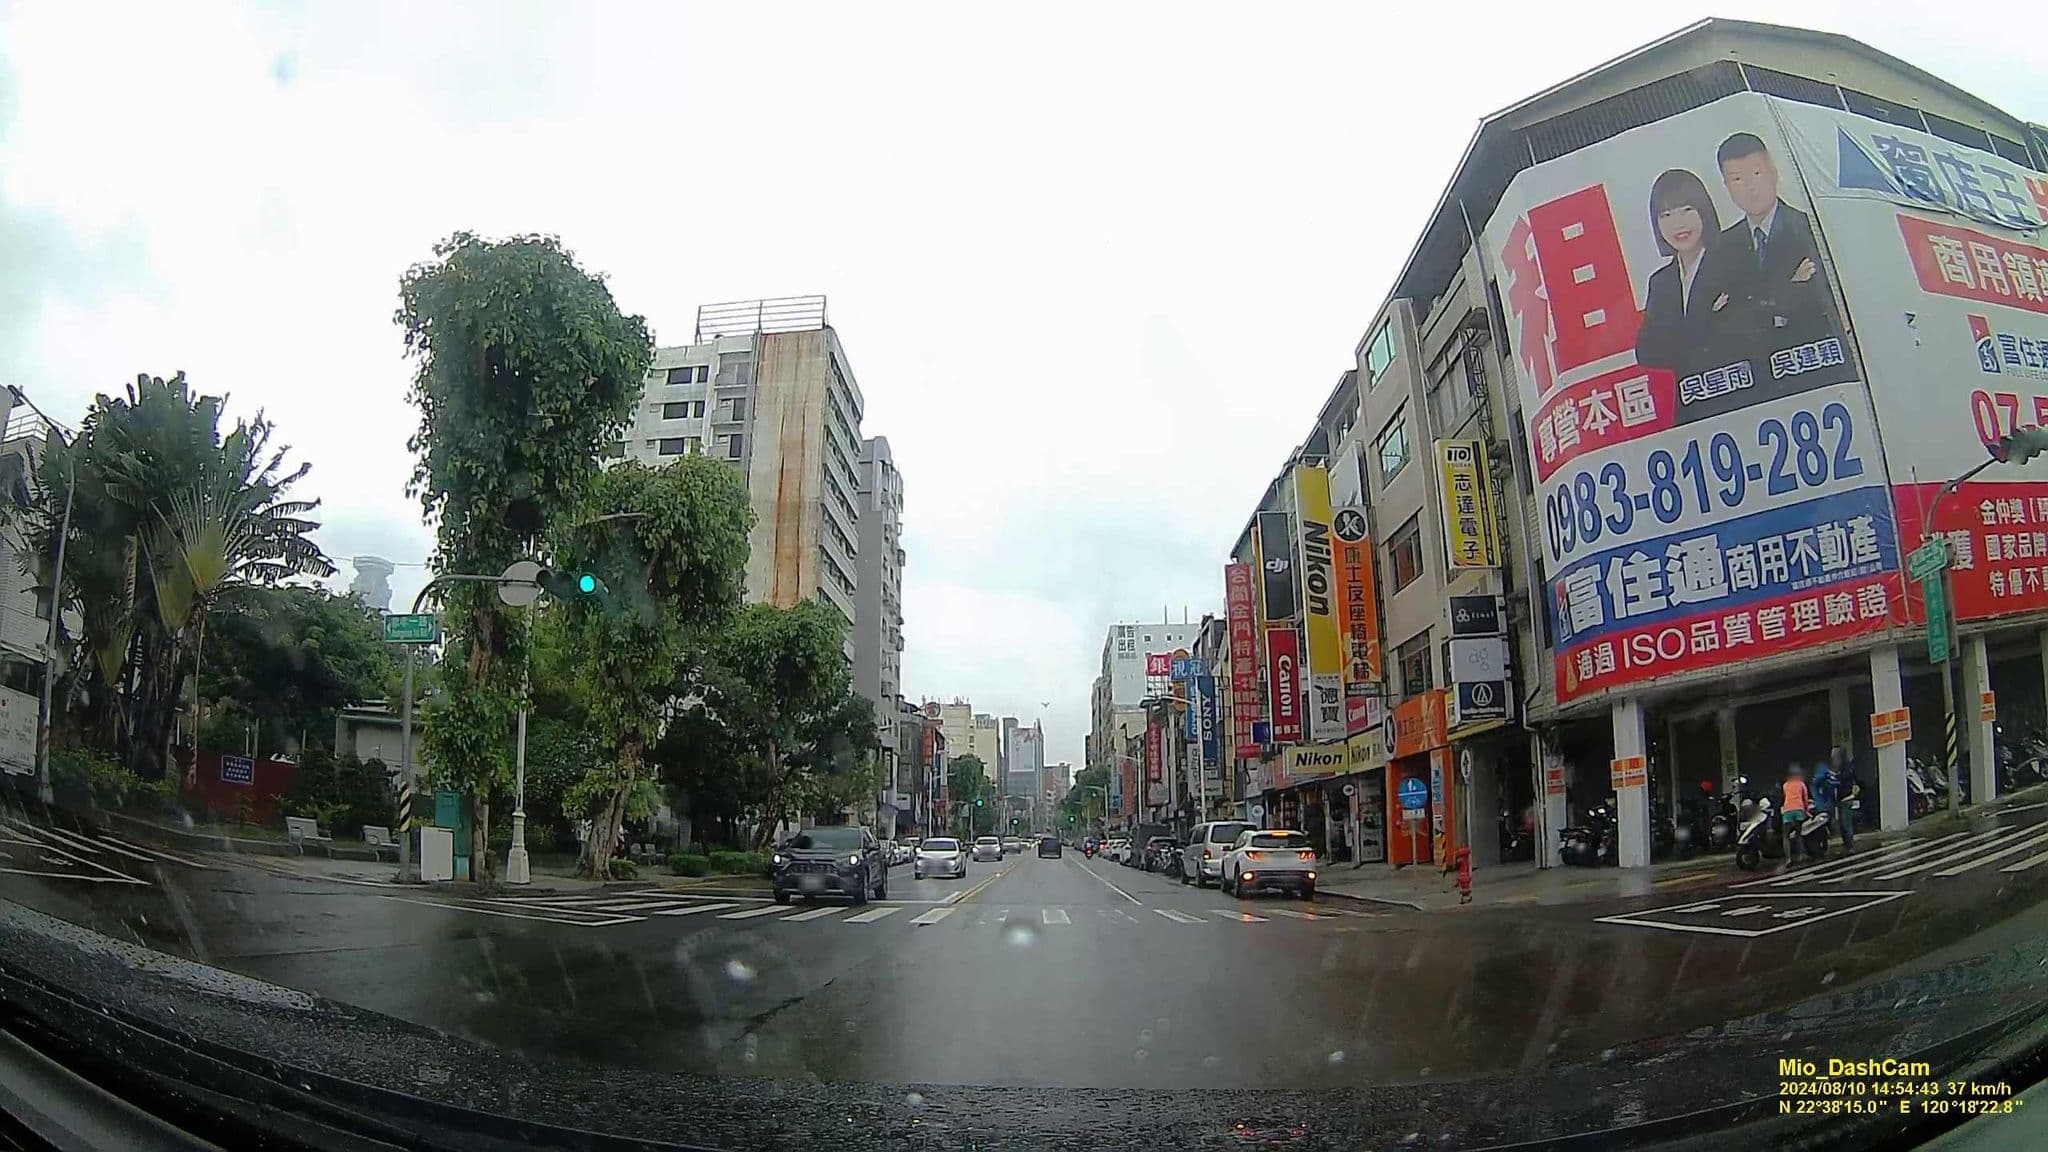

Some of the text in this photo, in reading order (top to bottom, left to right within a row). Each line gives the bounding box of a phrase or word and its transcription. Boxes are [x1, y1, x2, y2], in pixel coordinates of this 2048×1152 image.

[1501, 184, 1647, 398] 租
[1453, 473, 1479, 560] 志達電子
[1546, 402, 1865, 563] 0983-819-282
[1265, 557, 1289, 573] dji
[1303, 520, 1332, 617] Nikon
[1564, 515, 1882, 635] 富住通 商用不動產
[1921, 529, 1974, 571] 獲
[1989, 566, 2048, 598] 特優不
[1622, 628, 1687, 669] ISO
[1689, 583, 1889, 655] 品質管理驗證
[1203, 695, 1213, 741] SONY
[1277, 654, 1293, 717] Canon
[1296, 752, 1343, 768] Nikon
